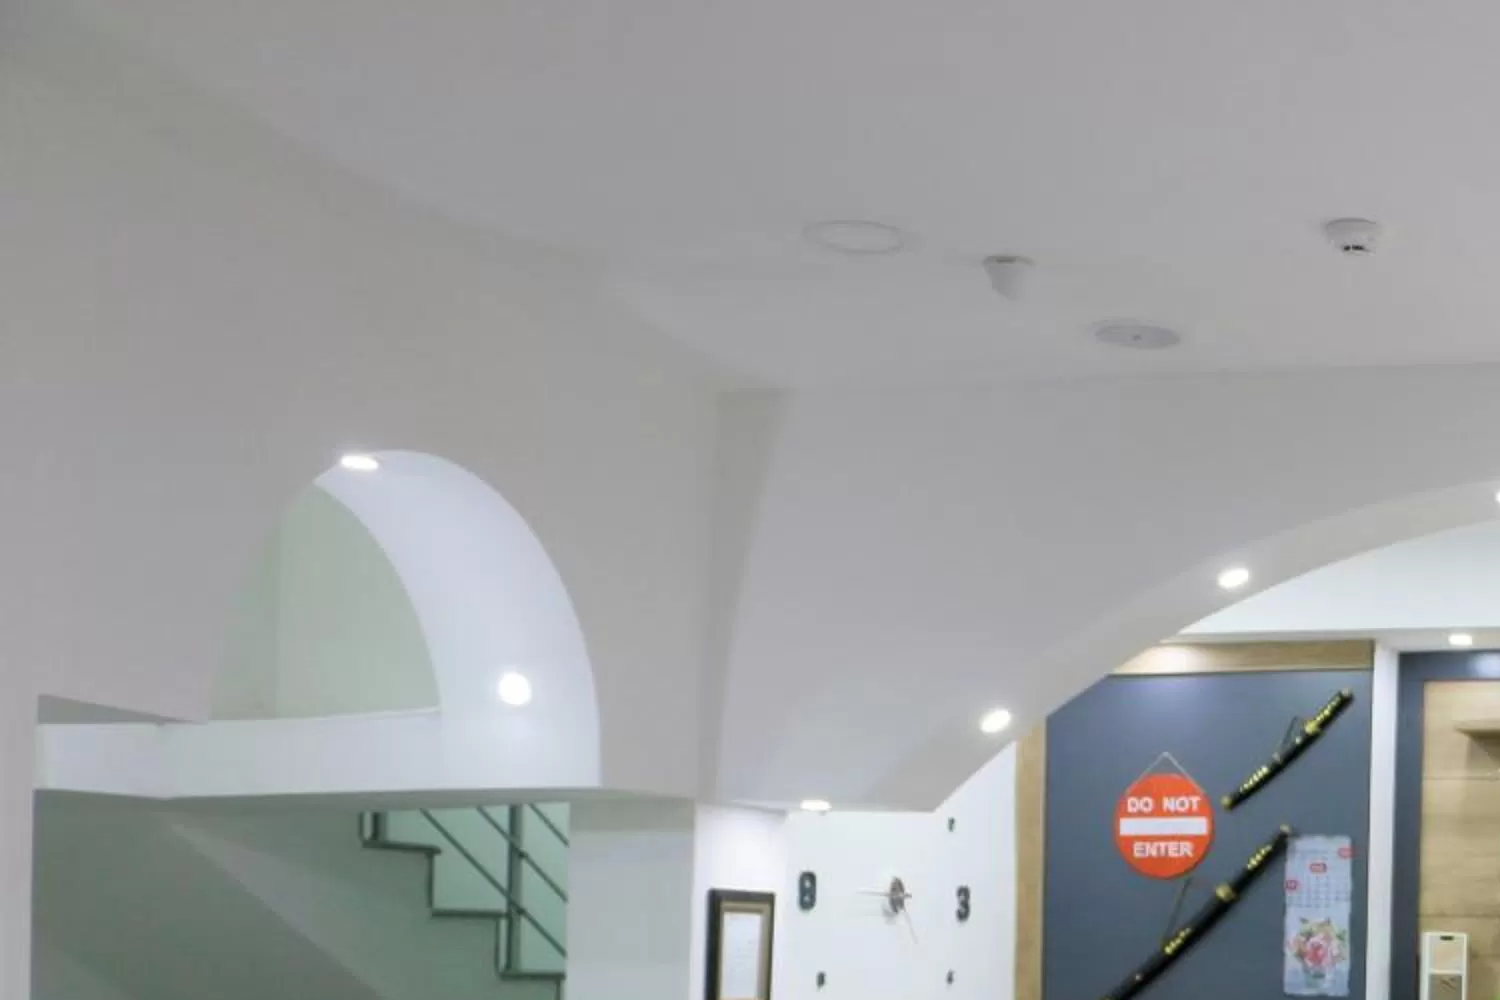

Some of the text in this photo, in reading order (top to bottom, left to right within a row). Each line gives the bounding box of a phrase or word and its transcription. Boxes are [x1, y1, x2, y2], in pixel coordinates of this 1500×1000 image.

[1127, 796, 1201, 813] DO NOT
[1133, 842, 1194, 858] ENTER
[956, 885, 970, 922] 3
